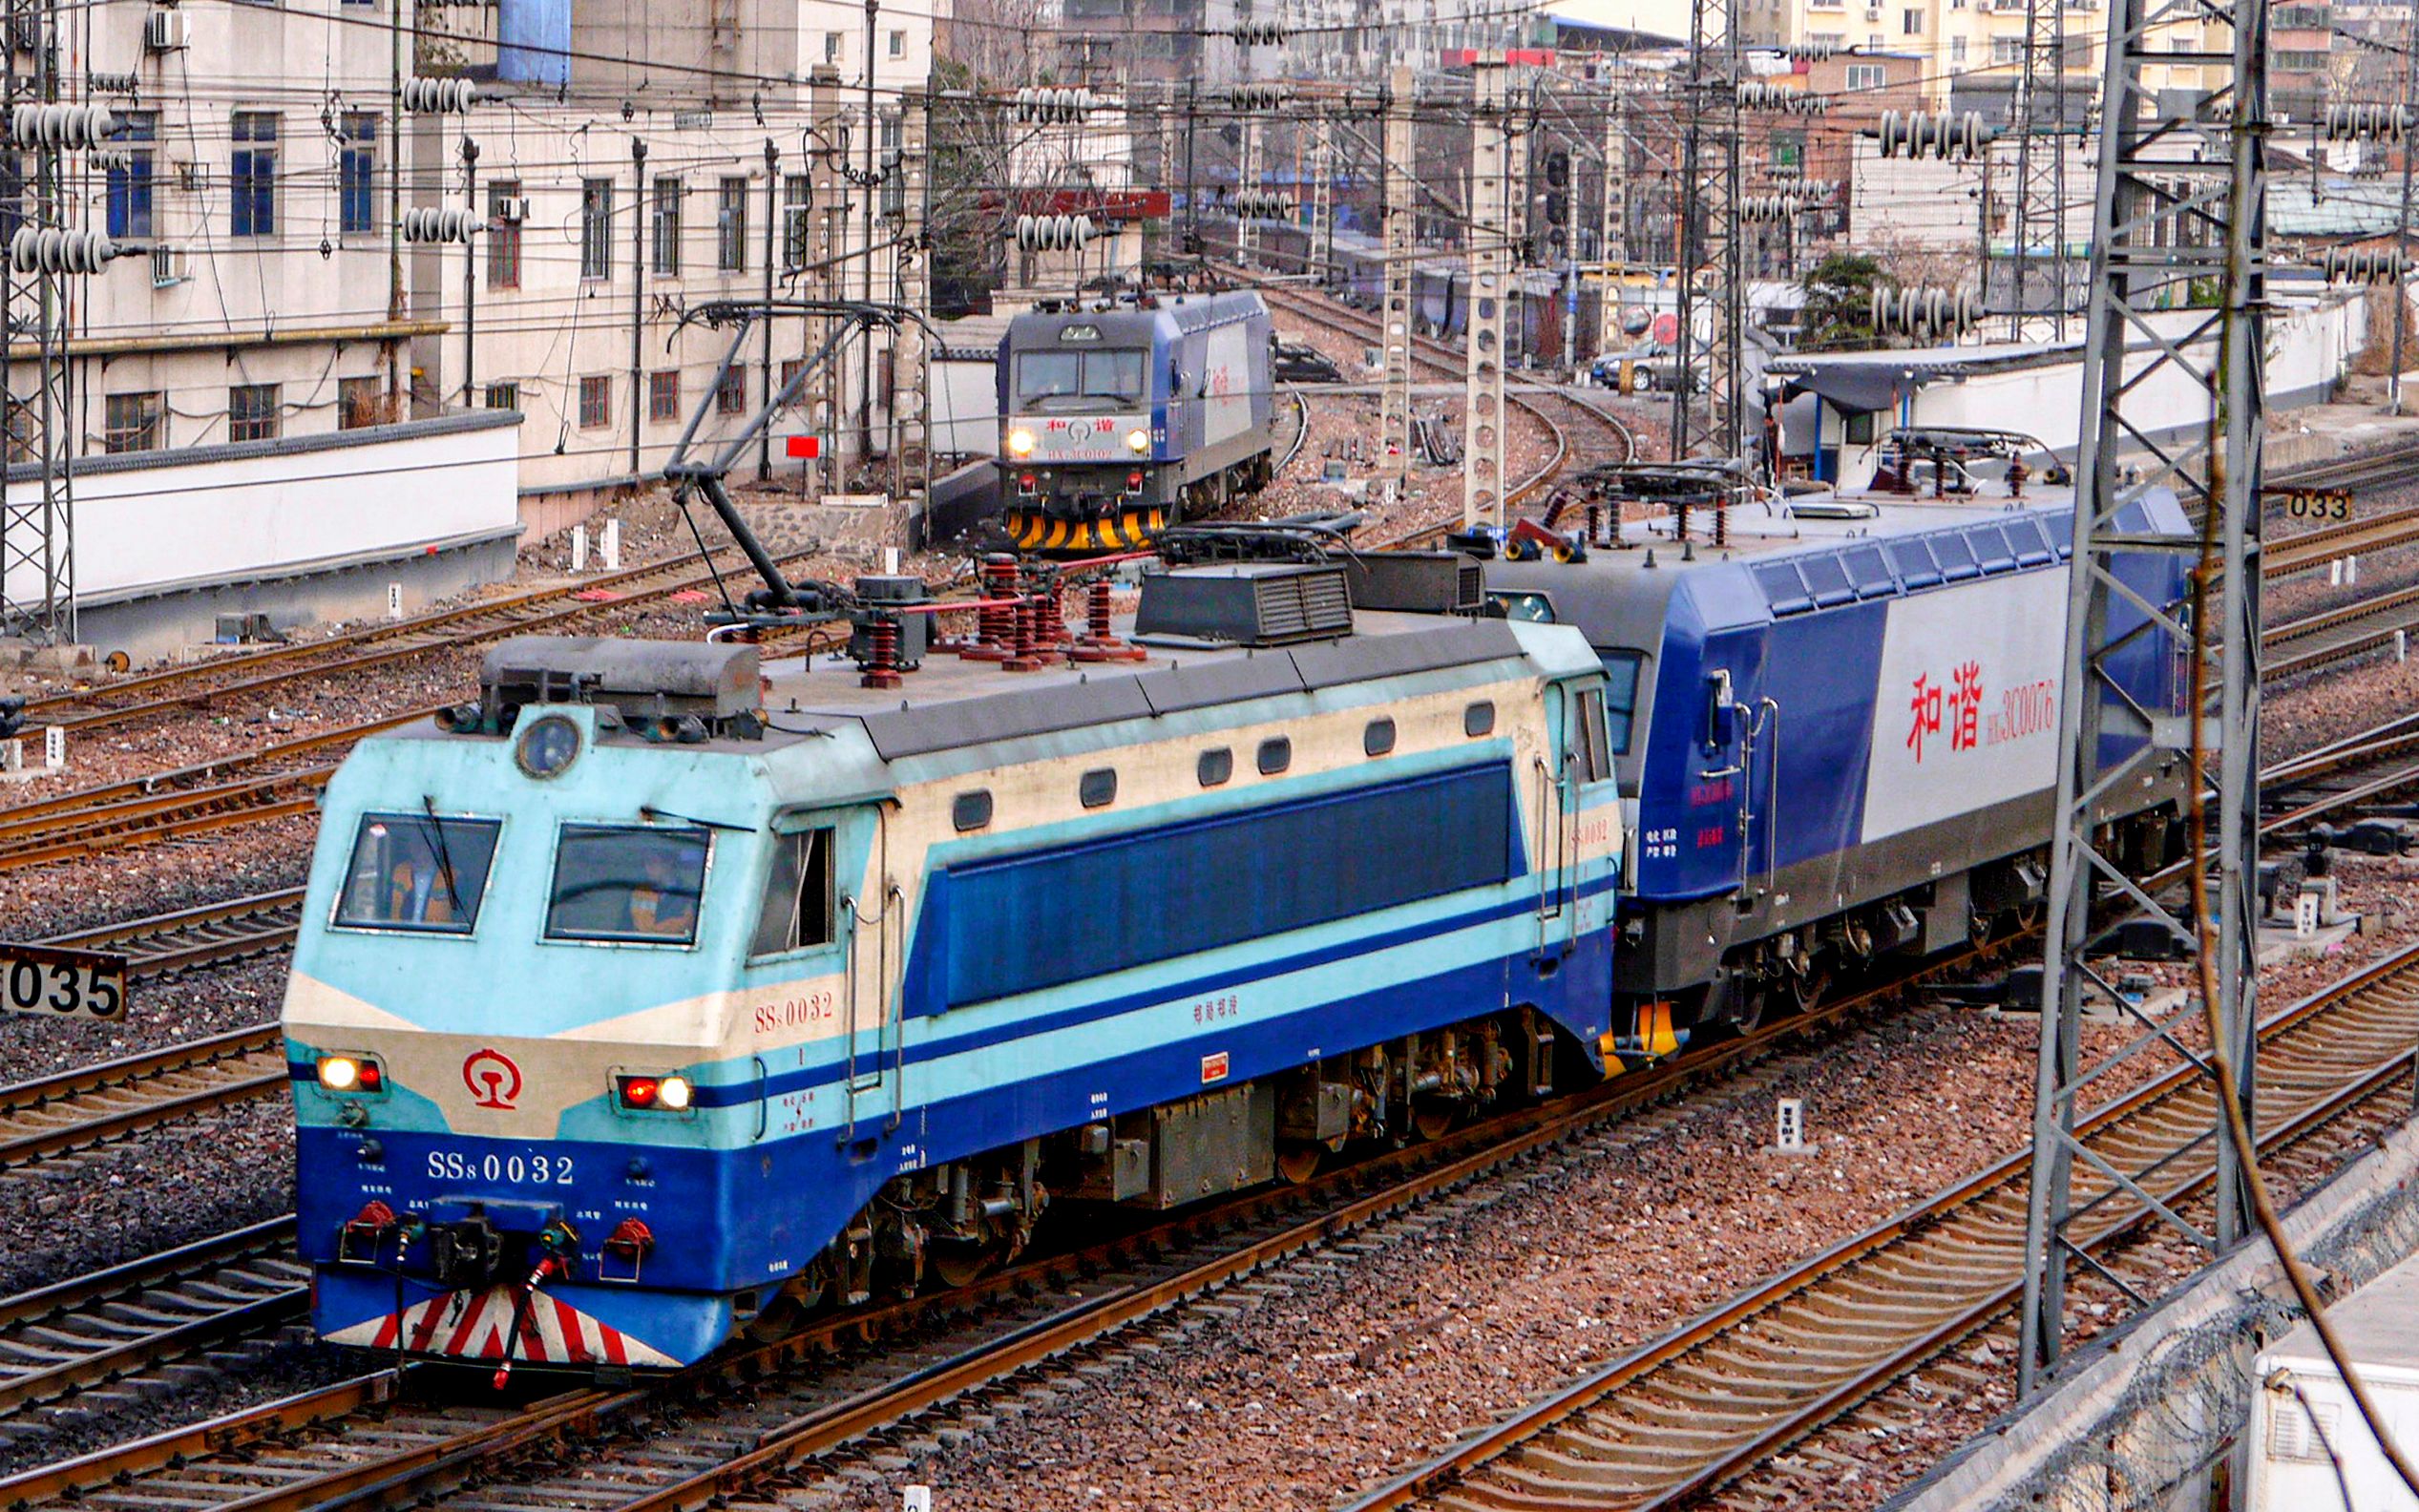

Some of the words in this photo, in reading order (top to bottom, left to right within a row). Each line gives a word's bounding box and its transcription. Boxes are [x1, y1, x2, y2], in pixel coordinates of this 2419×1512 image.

[1046, 418, 1067, 432] 和
[2291, 493, 2347, 519] 033
[1906, 659, 1983, 765] 和谐
[10, 957, 119, 1017] 035
